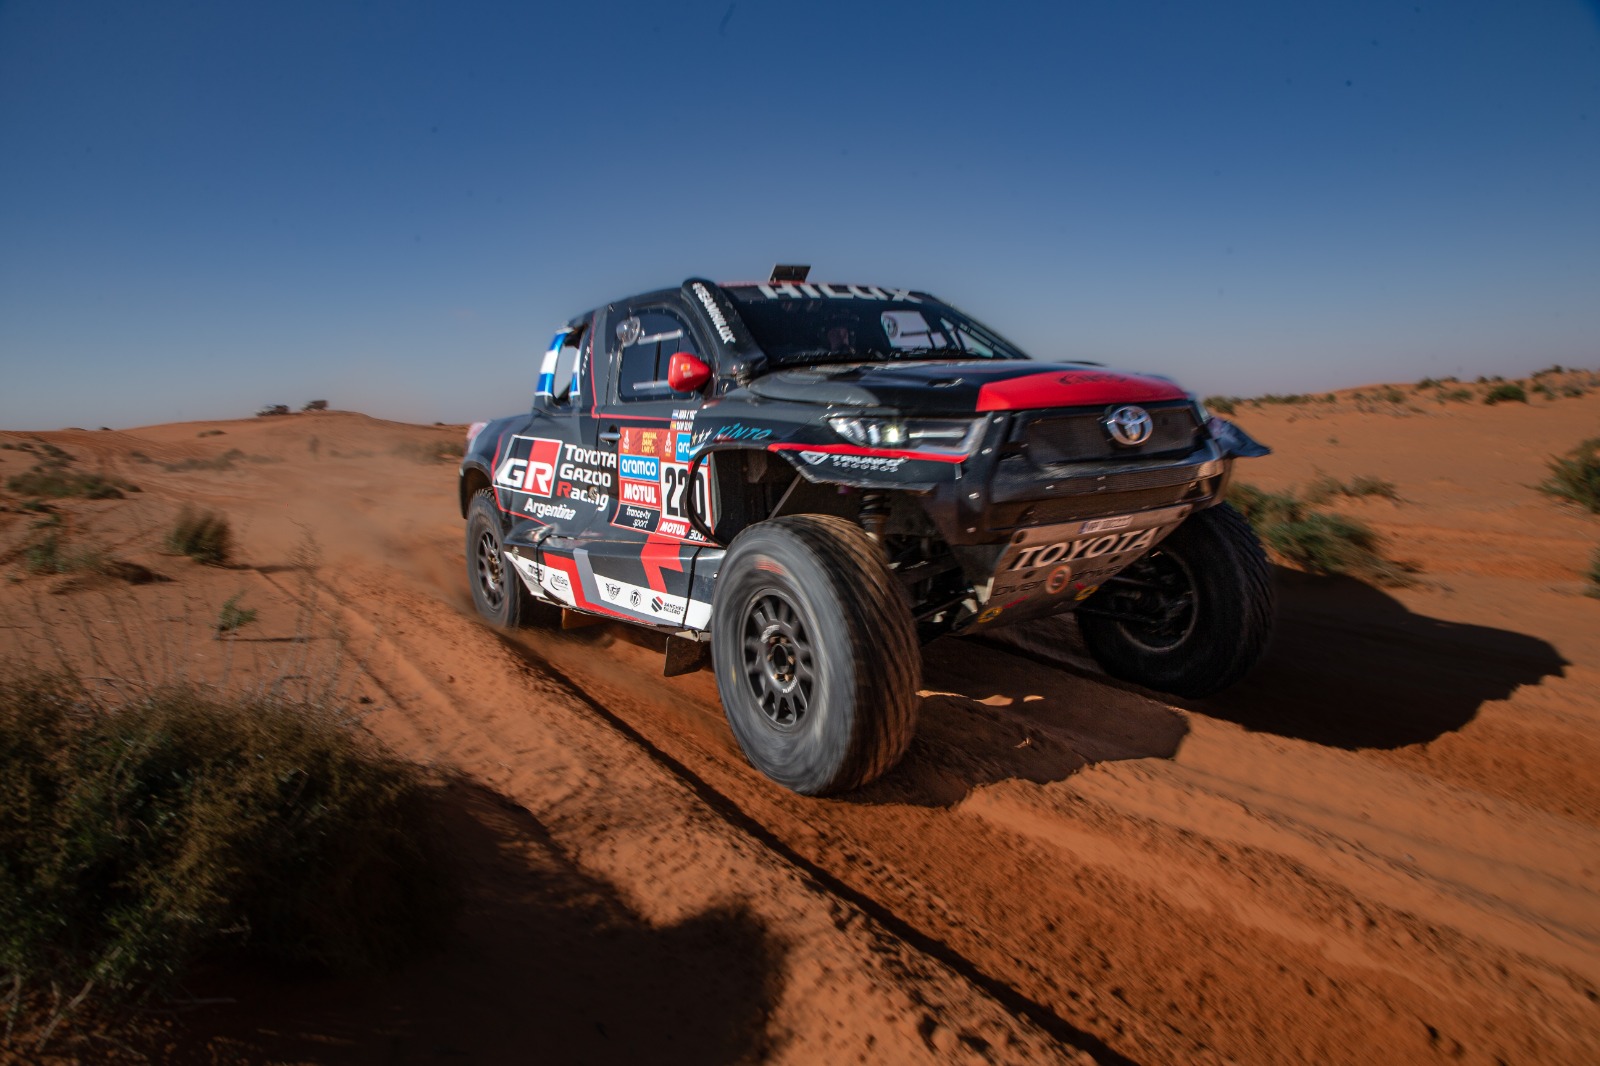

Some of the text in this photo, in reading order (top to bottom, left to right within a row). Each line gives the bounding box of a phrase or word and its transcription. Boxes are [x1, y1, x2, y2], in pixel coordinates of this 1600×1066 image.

[757, 283, 922, 304] HILUX
[713, 422, 772, 440] KINTO
[564, 443, 617, 468] TOYOTA
[497, 458, 553, 494] GR
[560, 463, 611, 487] GAZOO
[622, 459, 656, 476] aramco
[623, 483, 657, 503] MOTUL
[664, 467, 706, 523] 220
[524, 498, 576, 520] Argentina
[633, 519, 649, 528] sport
[660, 521, 686, 536] MOTUL
[1010, 526, 1160, 571] TOYOTA
